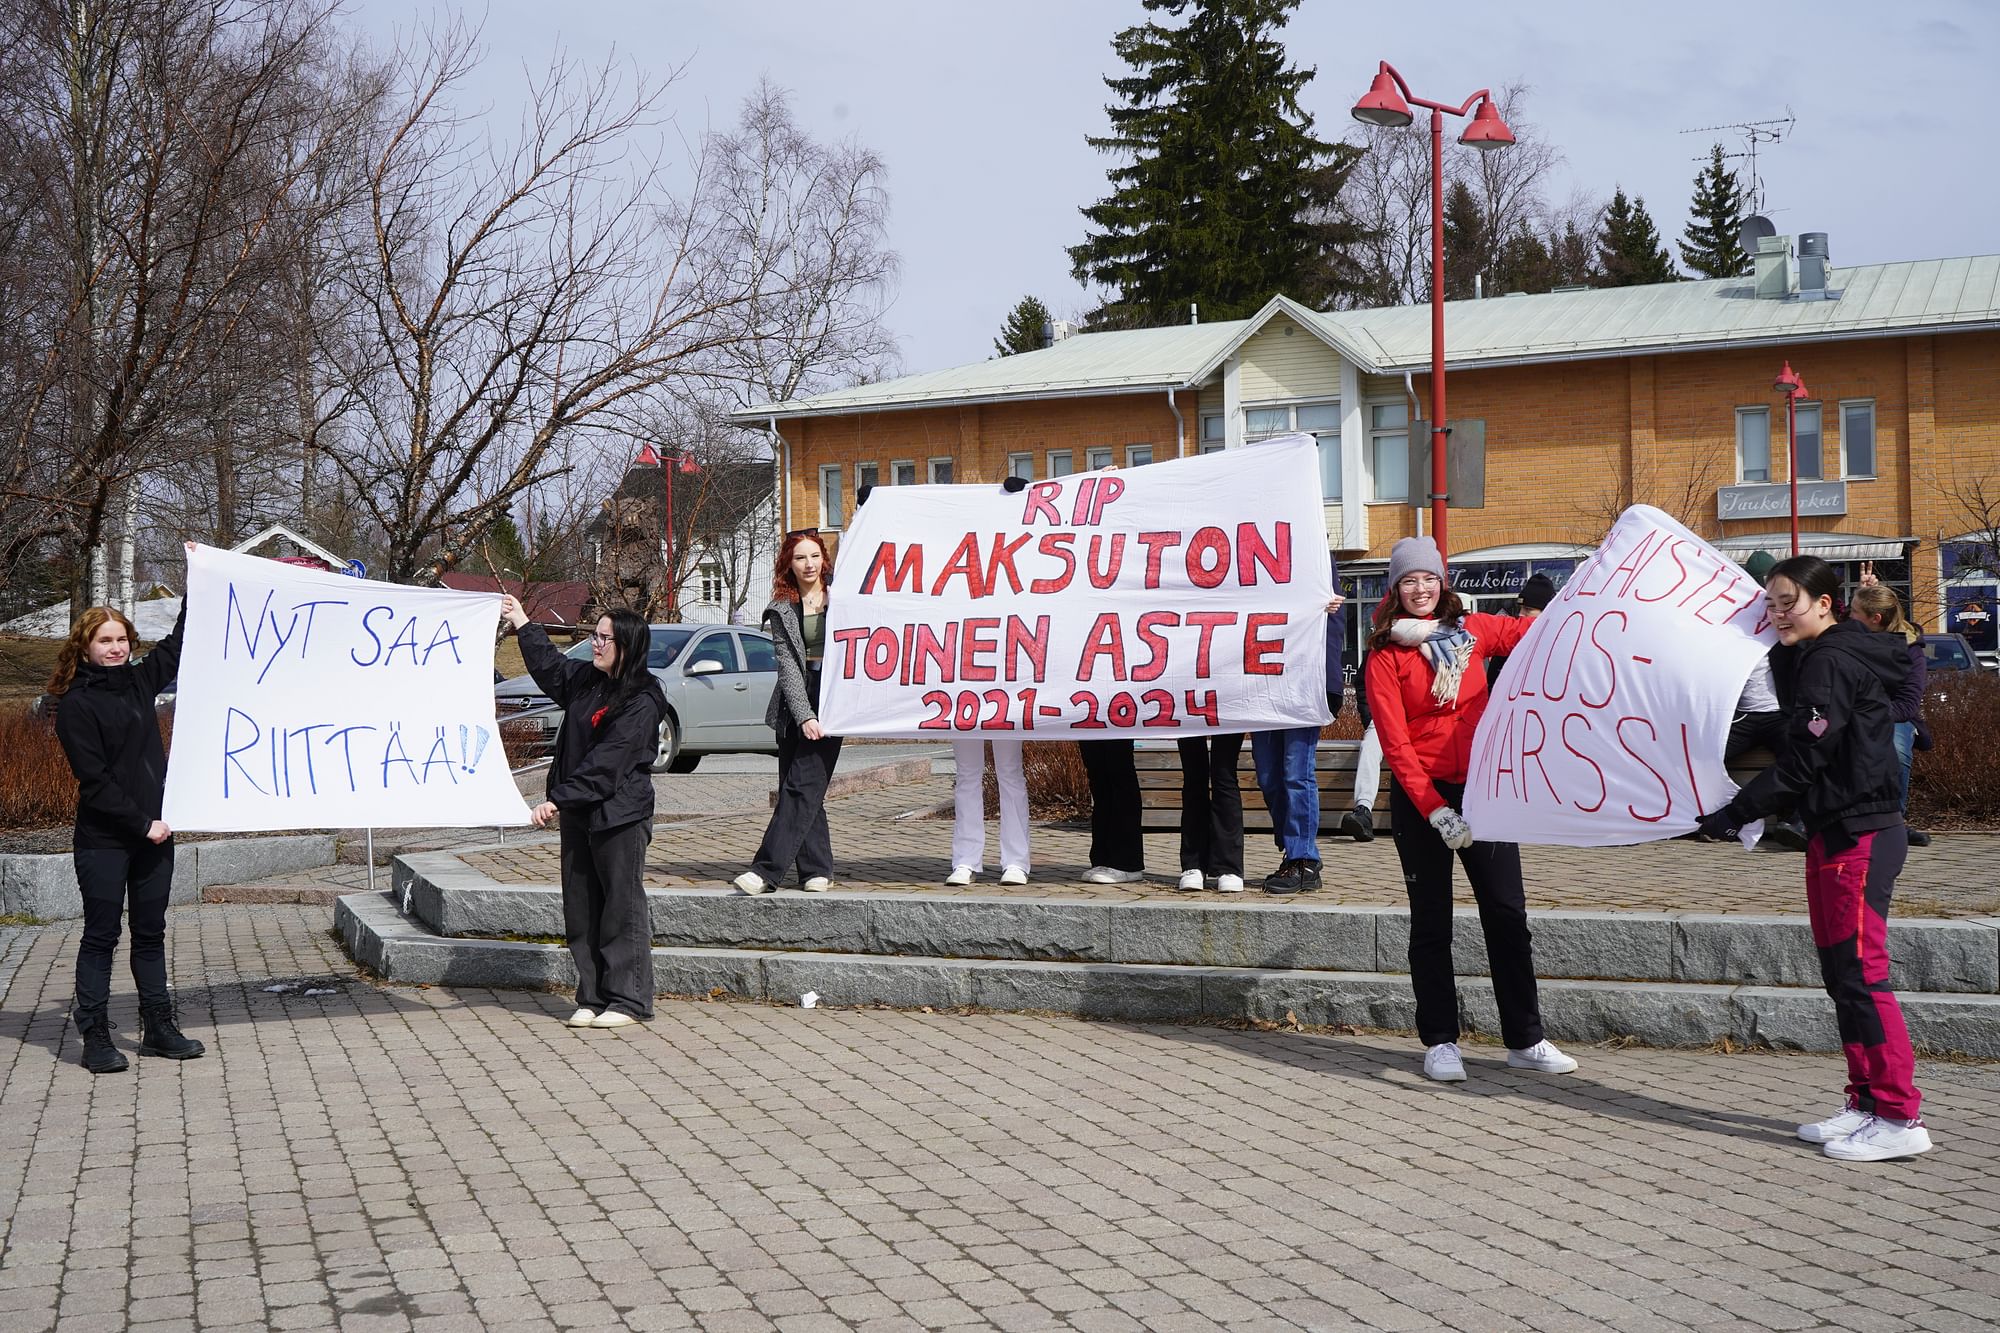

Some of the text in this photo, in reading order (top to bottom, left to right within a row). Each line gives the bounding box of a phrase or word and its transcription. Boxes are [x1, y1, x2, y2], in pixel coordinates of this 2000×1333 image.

[1723, 490, 1840, 512] Taukohrkut
[859, 522, 1291, 598] MAKSUTON
[1448, 568, 1564, 589] Taukohert
[350, 606, 462, 666] SAA
[834, 611, 1289, 684] TOINEN ASTE
[918, 688, 1219, 732] 2021-2024
[223, 707, 490, 799] RIITTÄÄ!!
